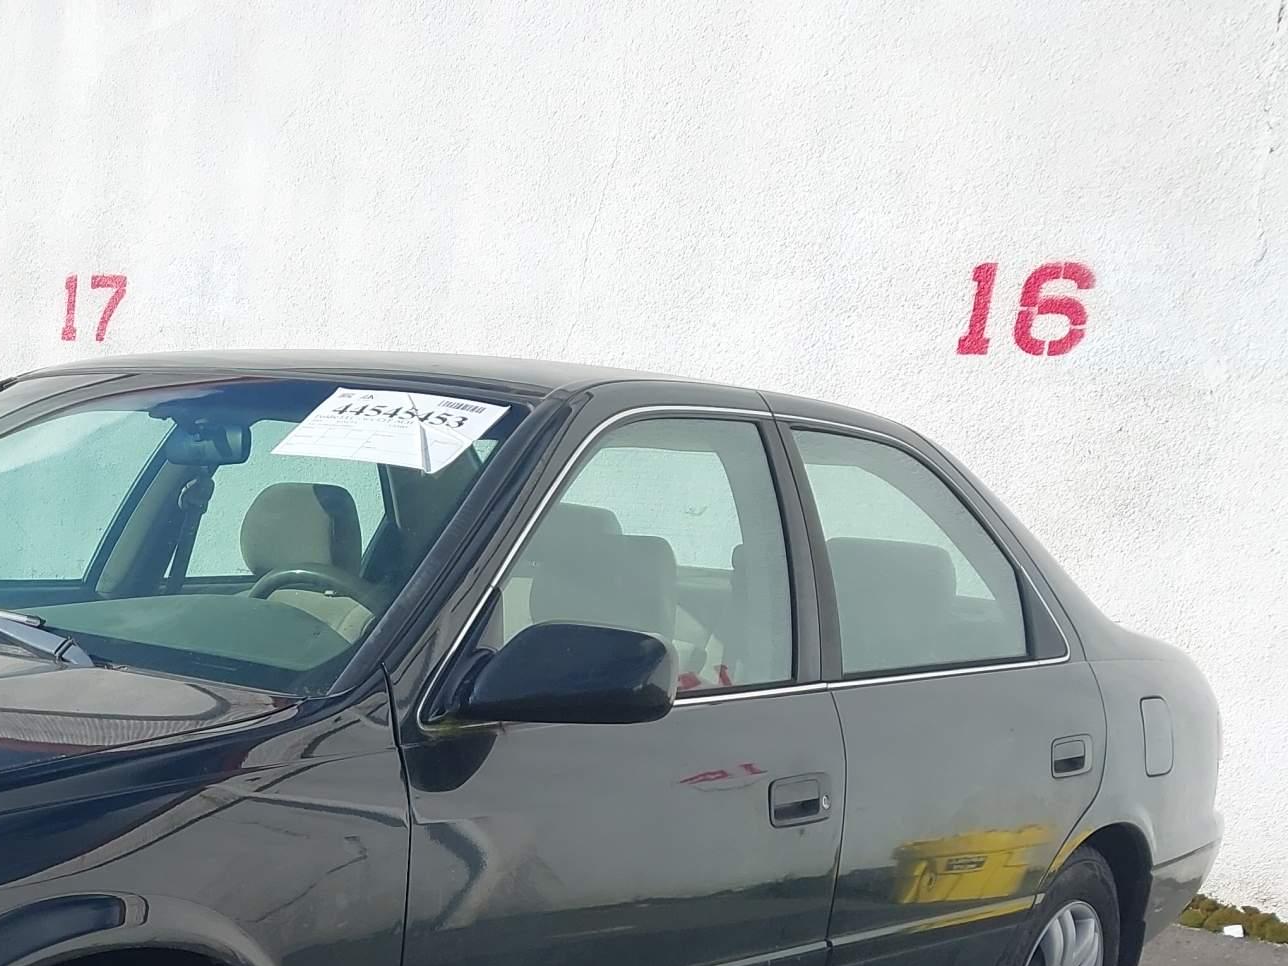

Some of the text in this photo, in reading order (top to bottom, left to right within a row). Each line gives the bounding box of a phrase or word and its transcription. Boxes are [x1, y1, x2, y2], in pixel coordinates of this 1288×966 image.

[62, 274, 127, 342] 17
[956, 261, 1096, 357] 16
[332, 403, 469, 429] 44545453
